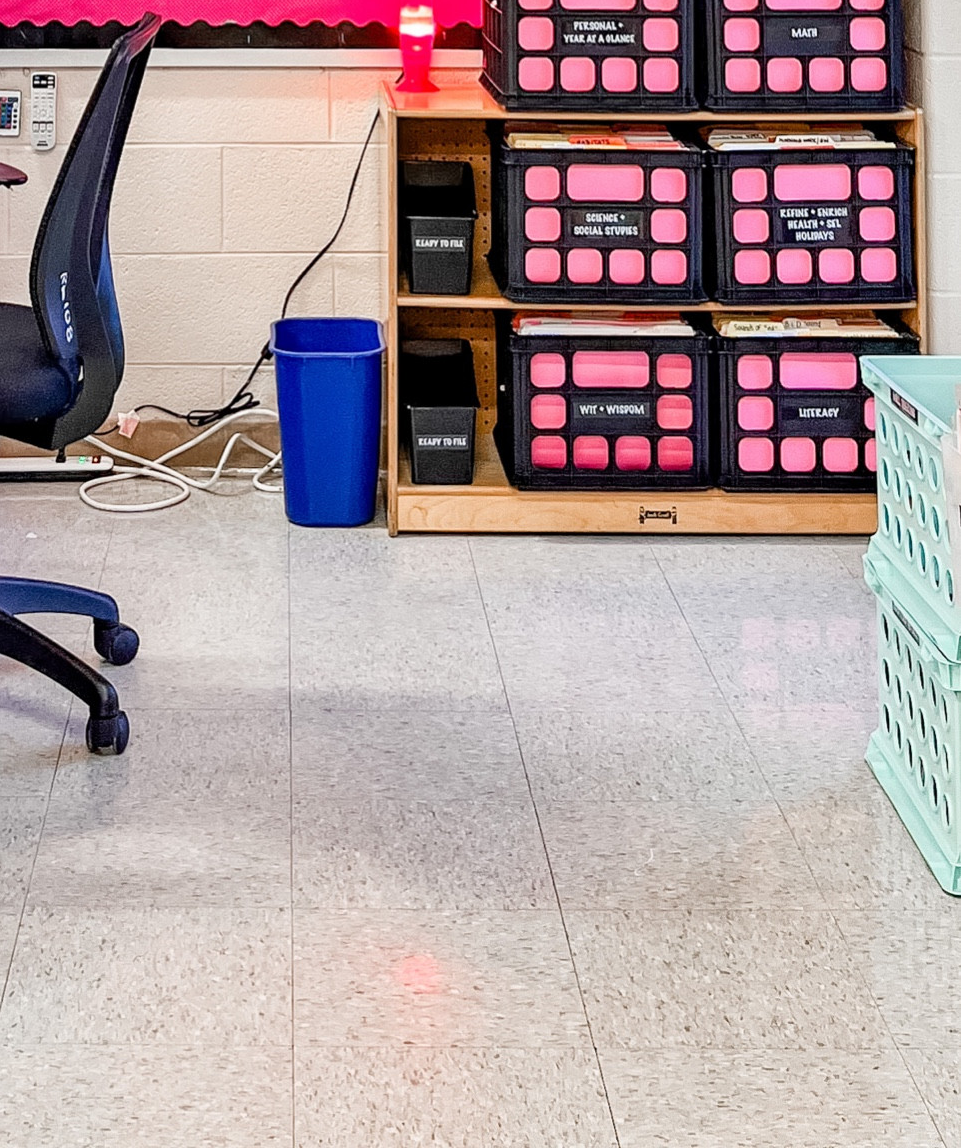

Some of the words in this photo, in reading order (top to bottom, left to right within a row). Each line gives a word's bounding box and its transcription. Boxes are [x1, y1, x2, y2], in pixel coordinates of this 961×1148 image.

[573, 21, 617, 31] PERSONAL
[791, 27, 818, 38] MATH
[563, 34, 586, 43] YEAR
[586, 34, 597, 44] AT
[598, 34, 605, 43] A
[605, 34, 635, 43] GLANCE
[585, 213, 619, 223] SCIENCE
[779, 208, 809, 218] REFINE
[816, 207, 849, 217] ENRICH
[787, 219, 819, 230] HEALTH
[826, 218, 842, 229] SEL
[573, 225, 604, 236] SOCIAL
[604, 225, 639, 236] STUDIES
[795, 230, 835, 242] HOLIDAYS
[415, 239, 439, 248] READY
[440, 239, 449, 248] TO
[450, 239, 463, 248] FILE
[579, 404, 598, 415] WIT
[605, 404, 645, 415] WISDOM
[798, 407, 840, 418] LITERACY
[418, 437, 442, 446] READY
[443, 437, 452, 446] TO
[453, 437, 467, 446] FILE
